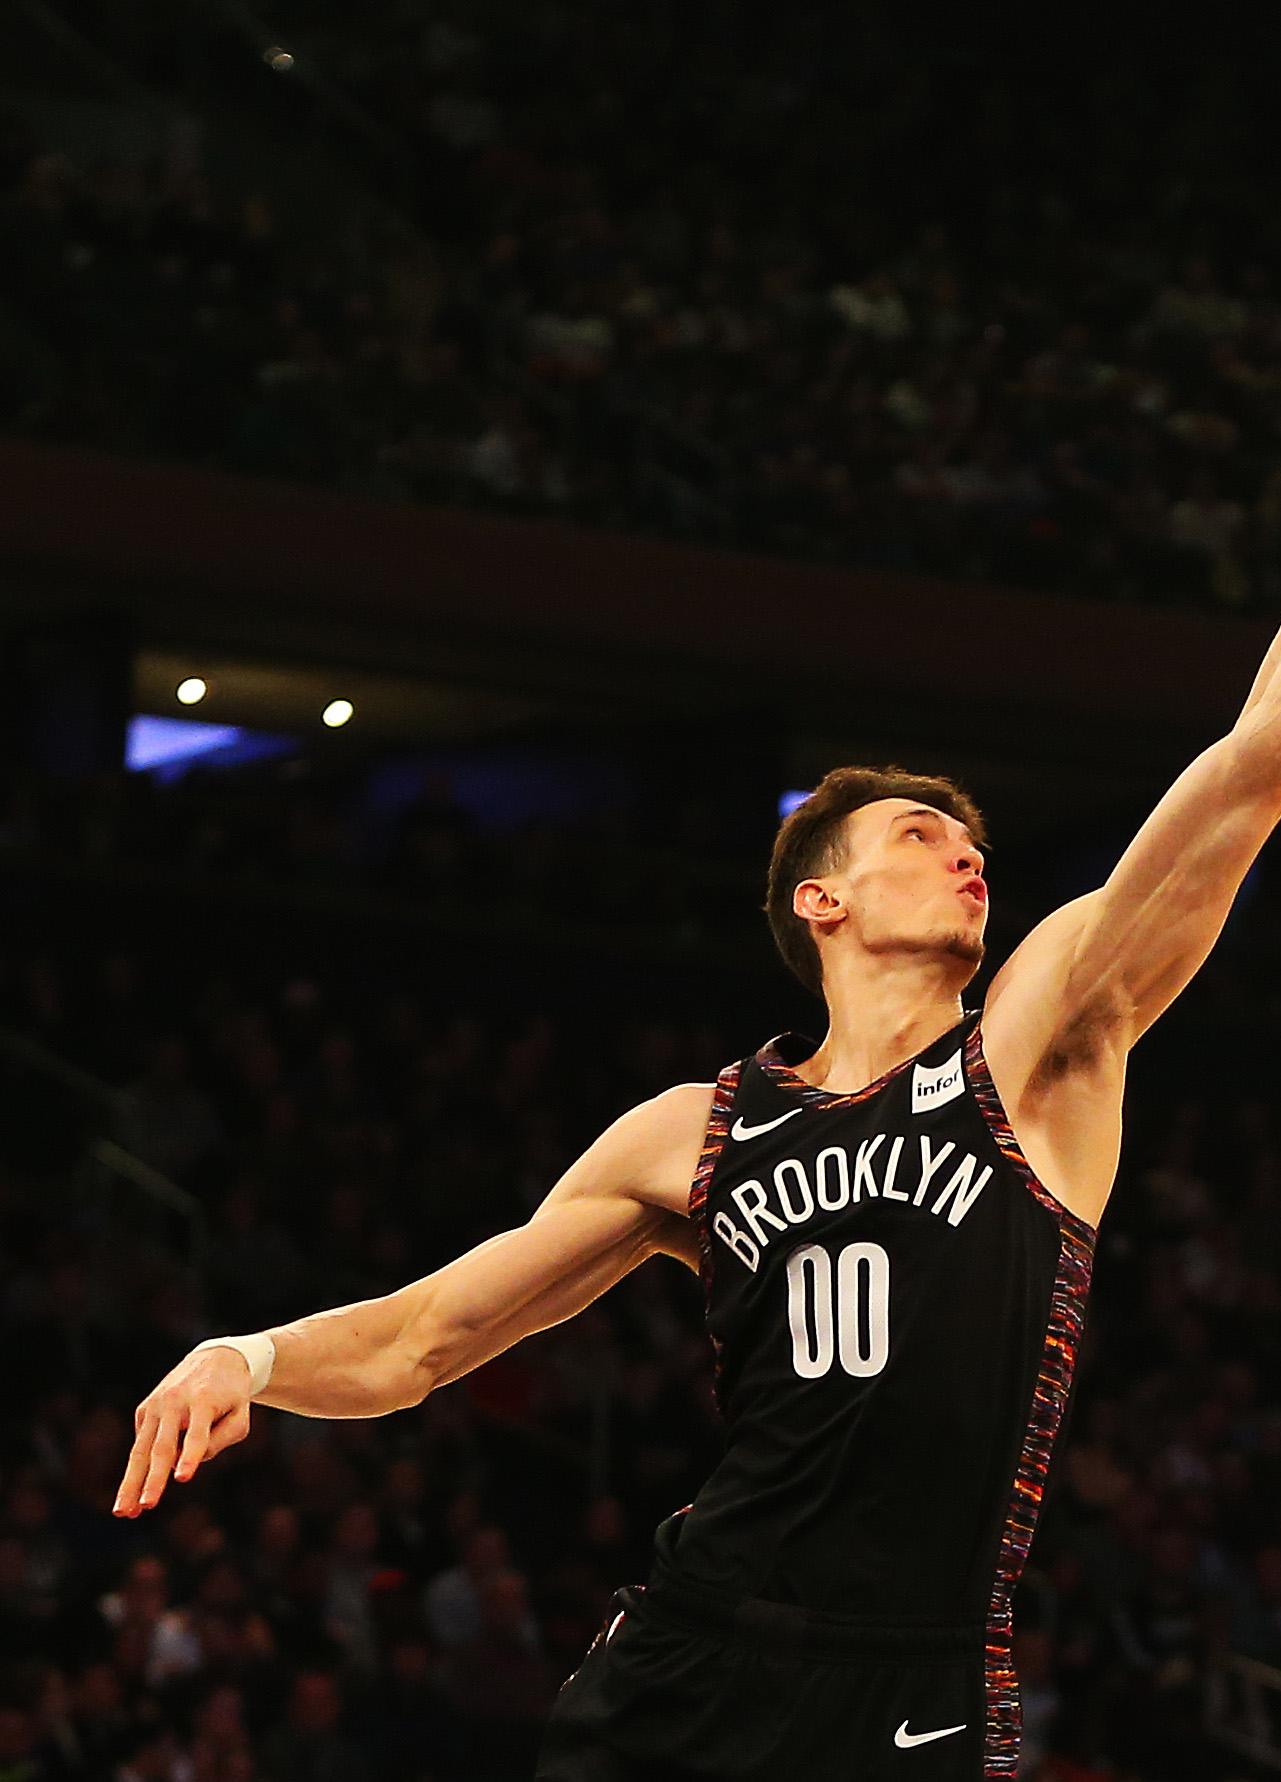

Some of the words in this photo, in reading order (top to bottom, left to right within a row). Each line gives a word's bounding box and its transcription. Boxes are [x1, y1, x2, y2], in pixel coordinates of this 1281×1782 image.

[917, 1069, 962, 1097] infor
[714, 1134, 994, 1272] BROOKLYN
[787, 1242, 889, 1378] 00
